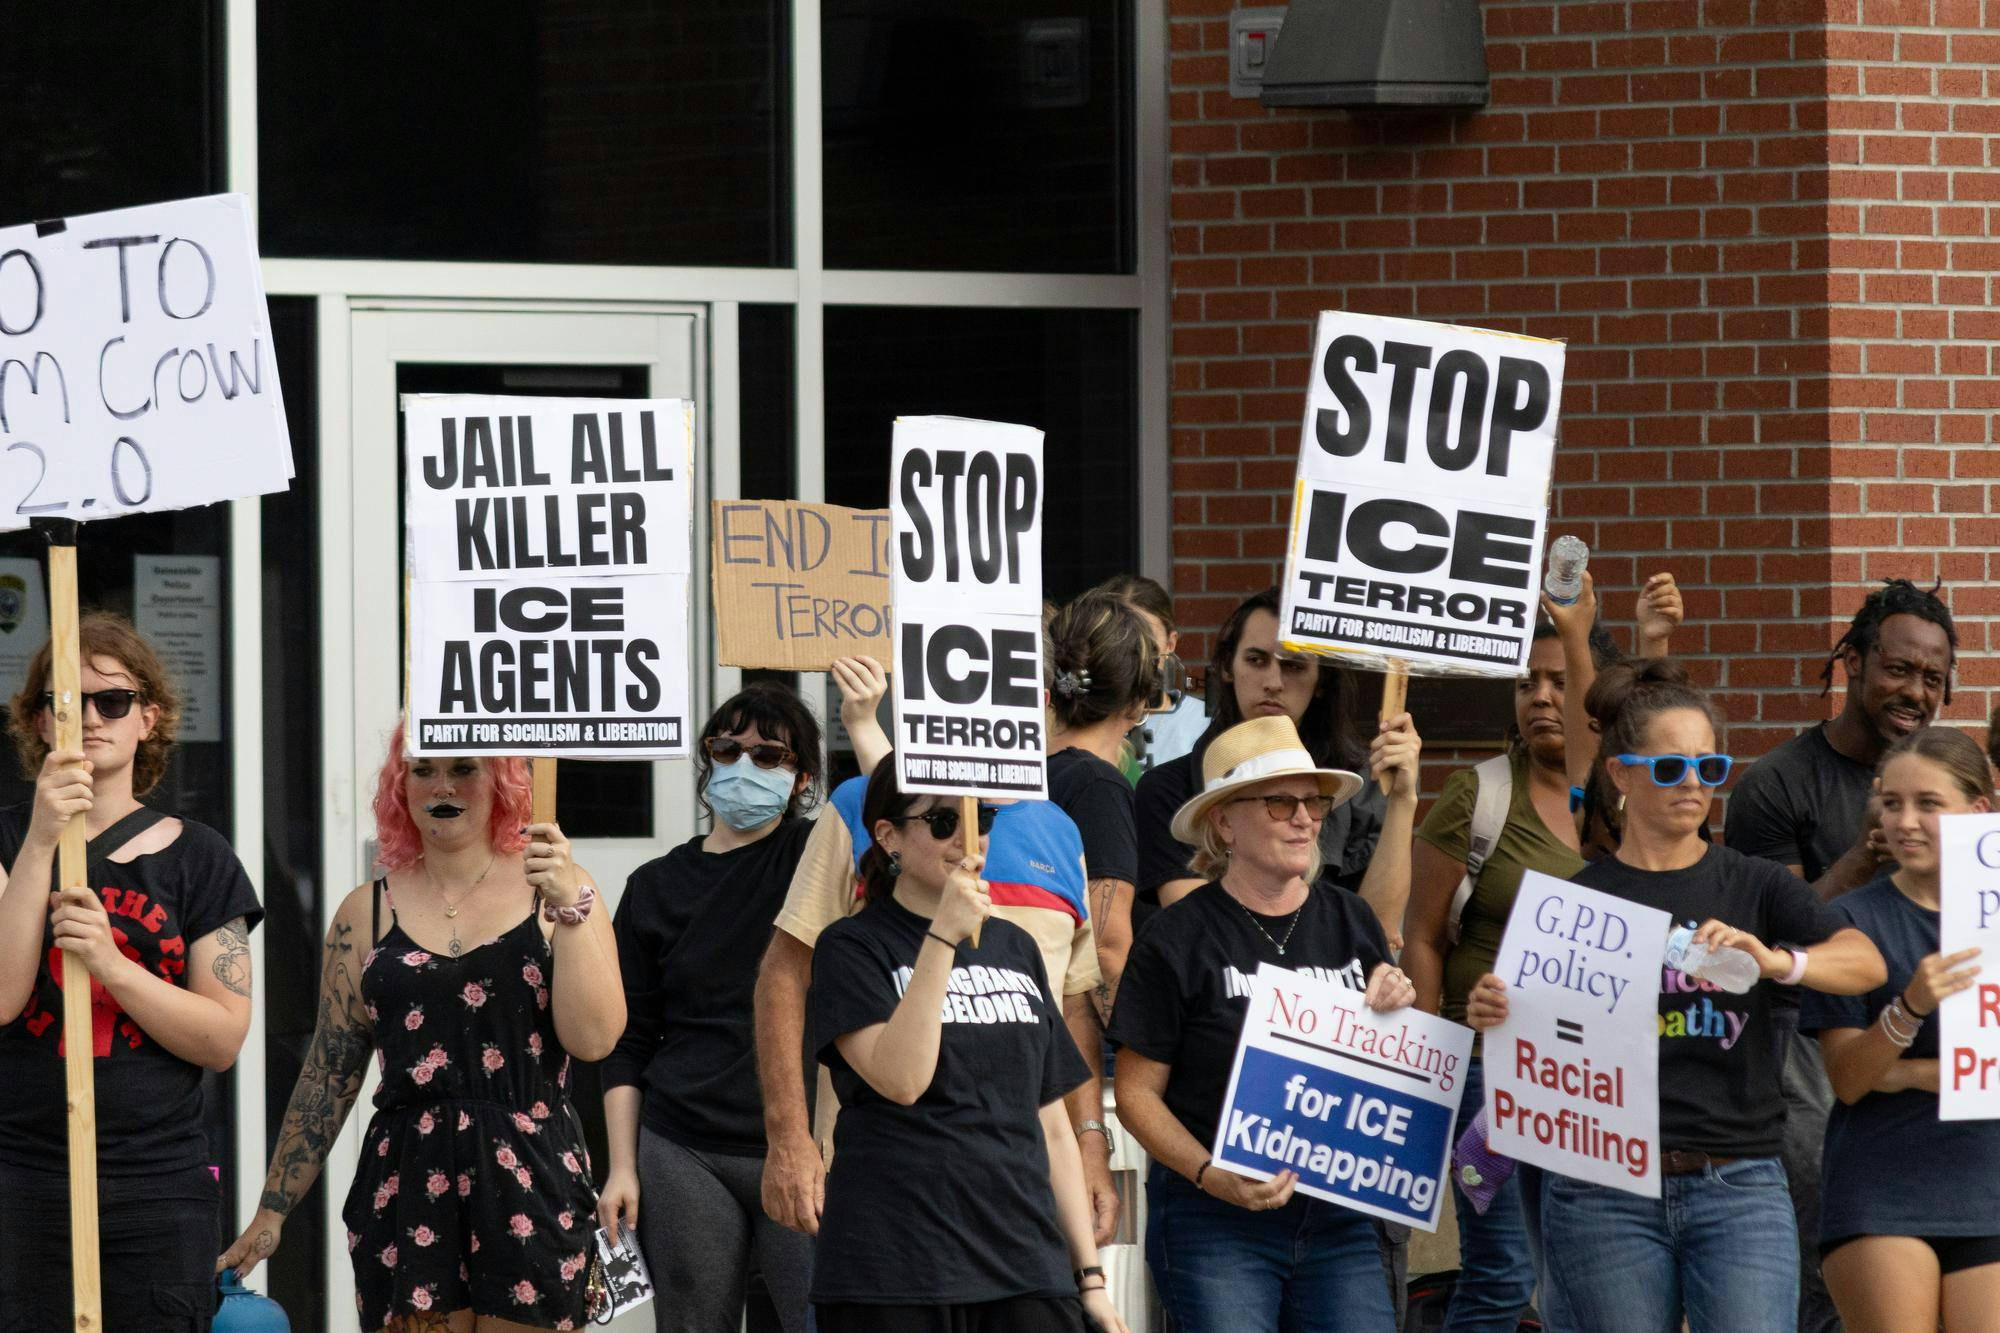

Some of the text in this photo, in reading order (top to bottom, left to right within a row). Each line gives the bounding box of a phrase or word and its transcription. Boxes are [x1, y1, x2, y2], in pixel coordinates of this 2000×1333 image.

[83, 234, 216, 323] TO
[1316, 334, 1551, 478] STOP
[8, 436, 152, 515] 2.0
[423, 410, 674, 490] JAIL ALL
[455, 492, 648, 571] KILLER
[722, 505, 831, 573] END
[900, 447, 1037, 584] STOP
[1304, 489, 1537, 590] ICE
[473, 587, 625, 633] ICE
[1296, 612, 1519, 659] PARTY FOR SOCIALISM & LIBERATION
[1299, 570, 1528, 630] TERROR
[439, 638, 661, 713] AGENTS
[902, 622, 1039, 708] ICE
[423, 722, 678, 743] PARTY FOR SOCIALISM & LIBERATION
[903, 713, 1041, 751] TERROR
[905, 758, 1042, 785] PARTY FOR SOCIALISM & LIBERATION
[101, 886, 168, 933] THE
[1535, 895, 1633, 959] G.P.D.
[1513, 949, 1631, 1014] policy
[1266, 987, 1459, 1092] No Tracking
[1515, 1038, 1625, 1109] Racial
[1284, 1074, 1413, 1146] for ICE
[1494, 1087, 1650, 1179] Profiling
[1226, 1109, 1437, 1213] Kidnapping
